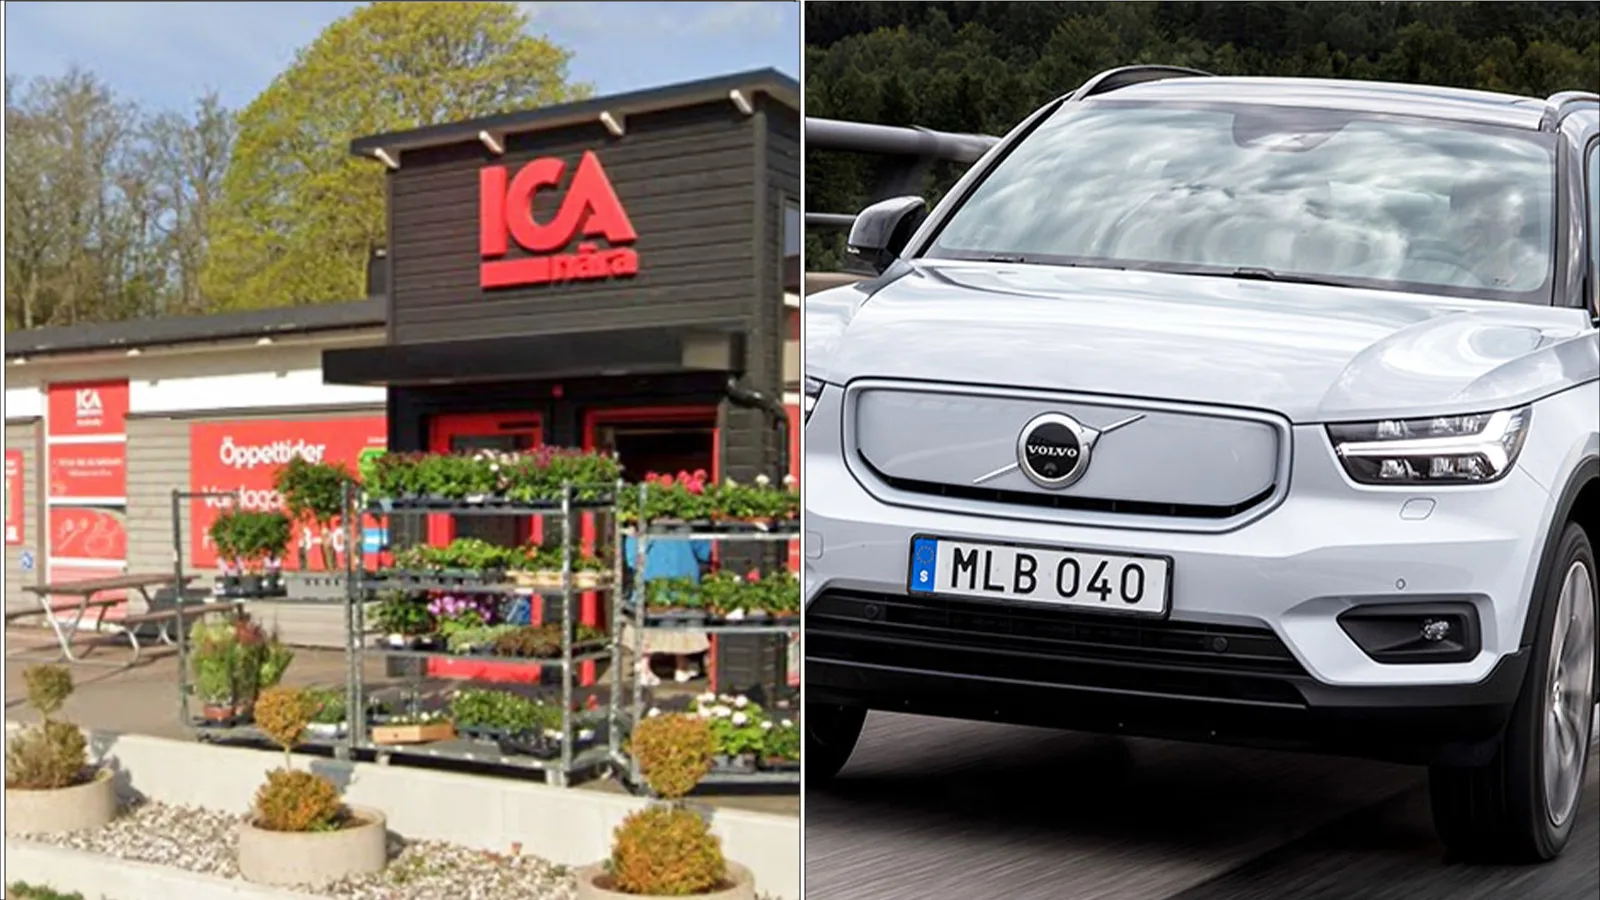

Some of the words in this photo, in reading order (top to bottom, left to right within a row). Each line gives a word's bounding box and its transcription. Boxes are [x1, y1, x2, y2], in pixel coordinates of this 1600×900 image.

[480, 150, 637, 259] ICA
[76, 389, 103, 409] ICA
[220, 436, 326, 469] Öppettider
[1027, 444, 1078, 458] VOLVO
[919, 570, 928, 583] S
[951, 547, 1038, 594] MLB
[1056, 557, 1145, 604] 040
